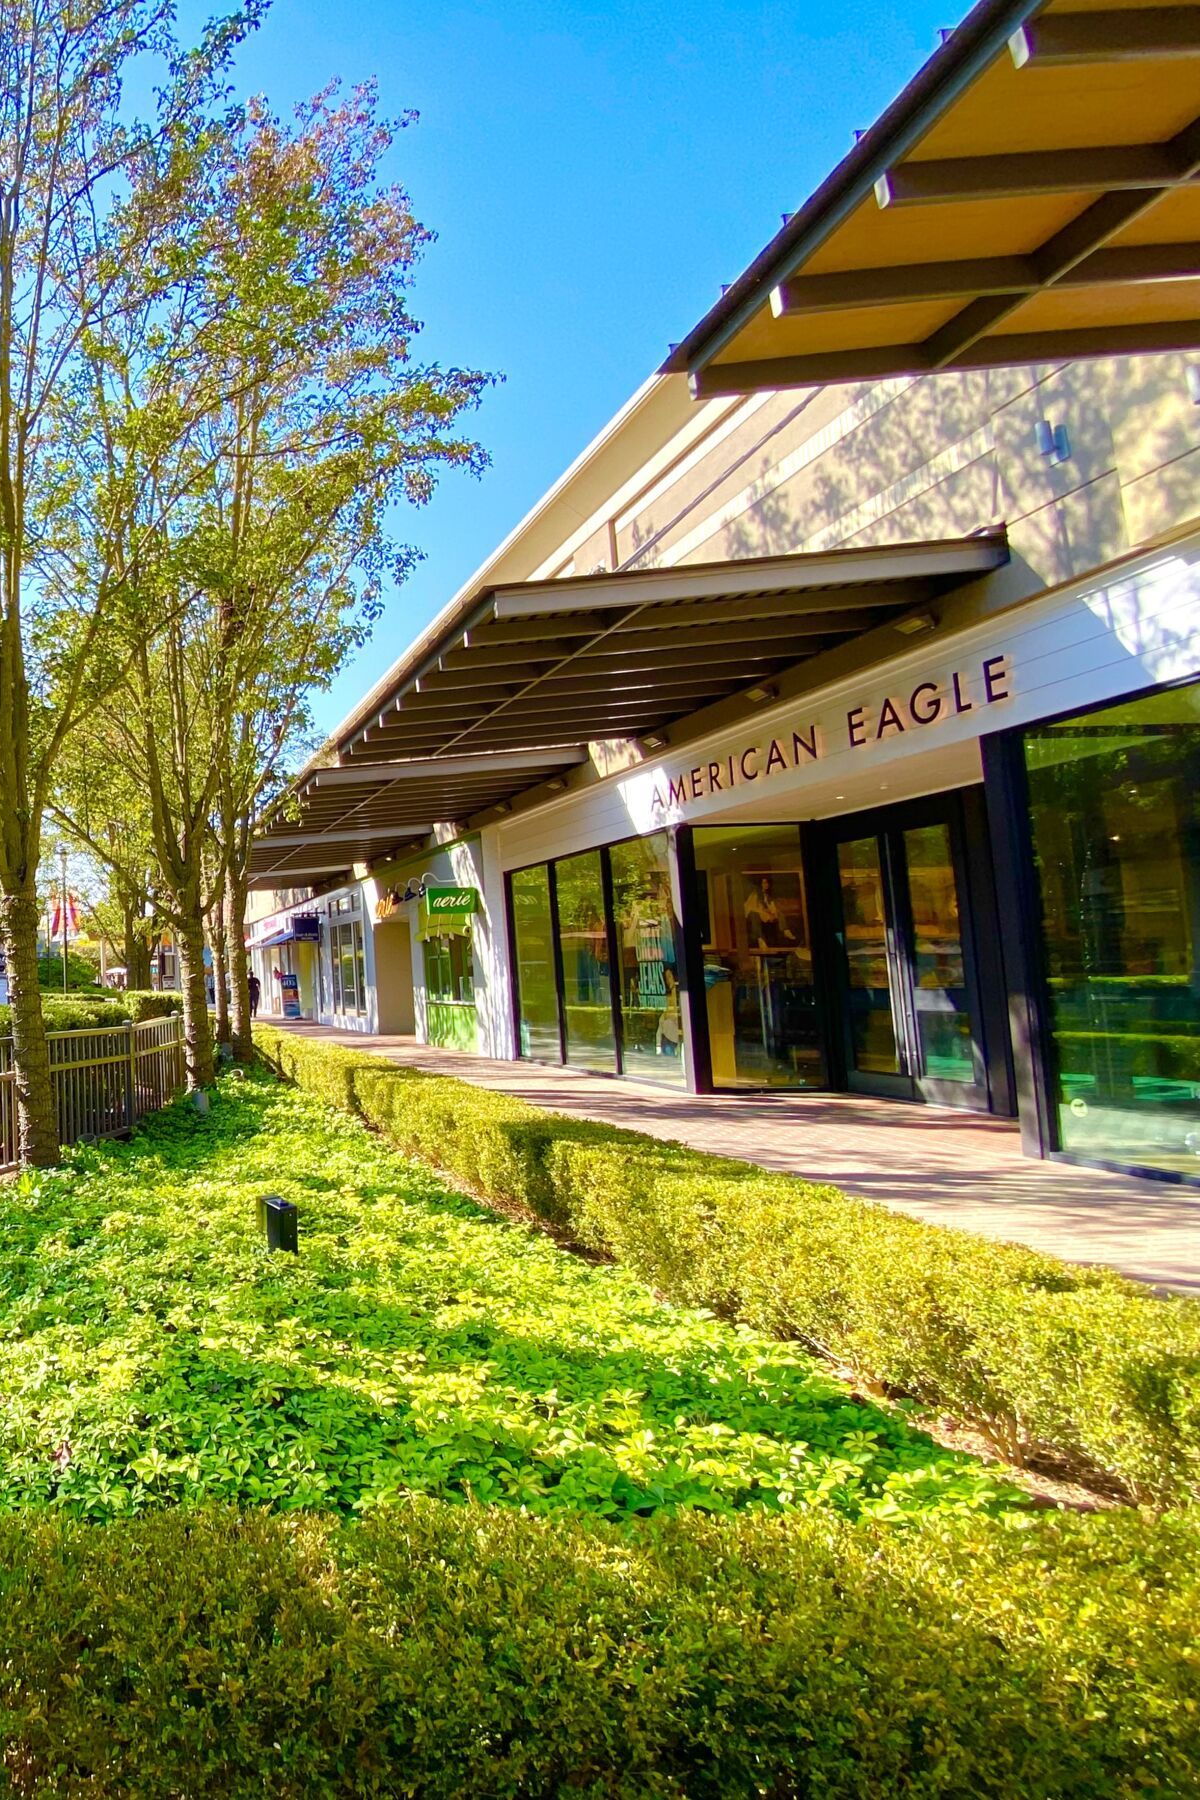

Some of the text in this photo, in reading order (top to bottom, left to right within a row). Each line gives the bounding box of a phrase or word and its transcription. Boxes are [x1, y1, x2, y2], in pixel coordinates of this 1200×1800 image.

[651, 655, 1009, 811] AMERICAN EAGLE
[432, 891, 471, 908] aerie
[638, 961, 667, 995] JEANS
